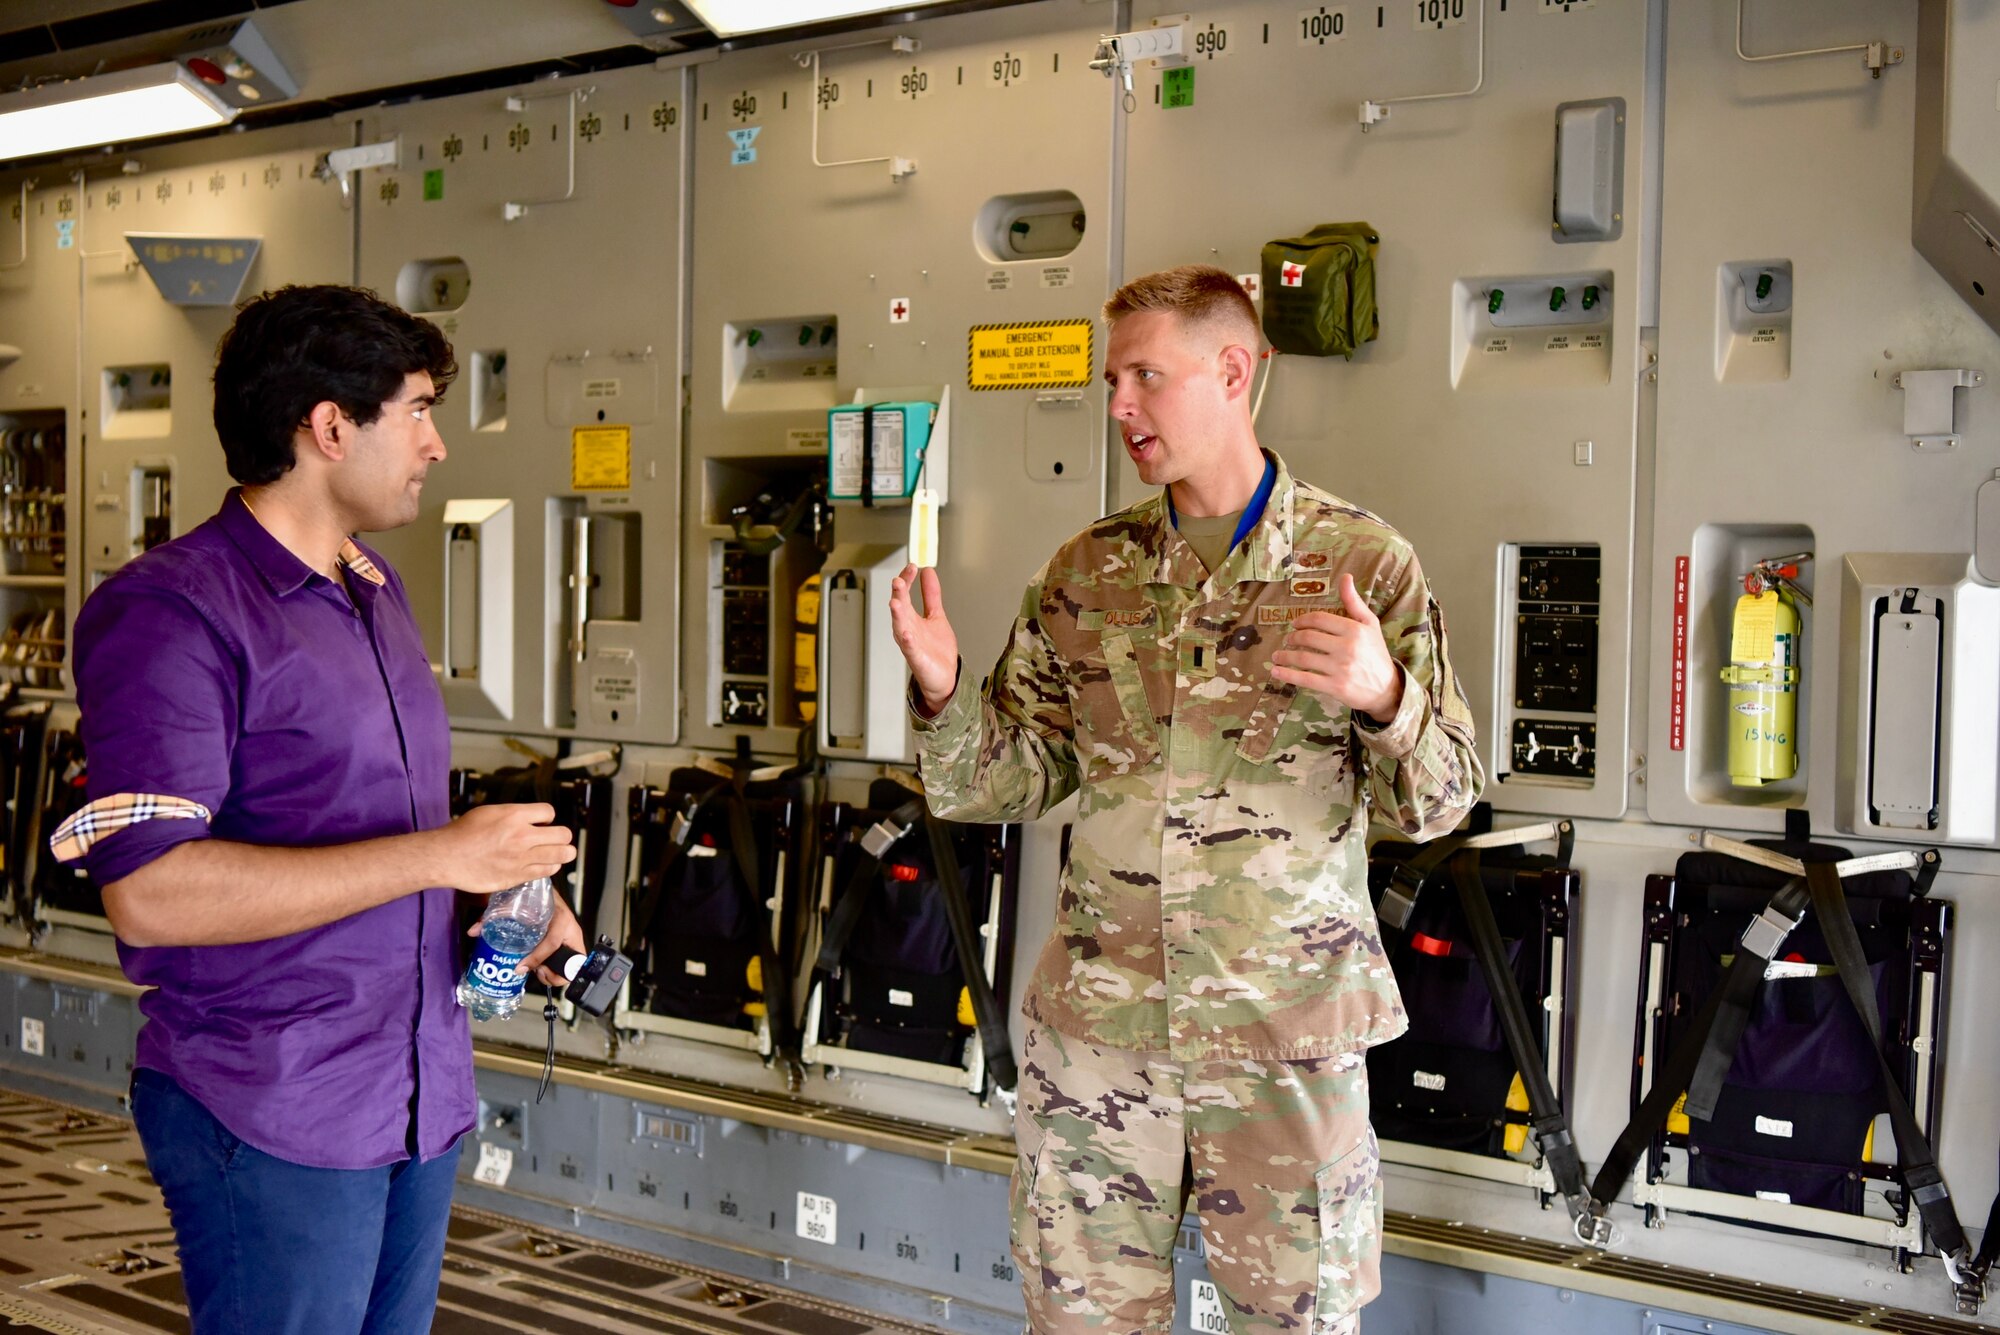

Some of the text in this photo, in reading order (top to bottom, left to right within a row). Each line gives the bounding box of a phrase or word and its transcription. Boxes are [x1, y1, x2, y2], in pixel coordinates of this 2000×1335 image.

[1418, 0, 1463, 23] 1010
[1301, 13, 1344, 39] 1000
[1196, 29, 1227, 53] 990
[993, 58, 1021, 80] 970
[901, 72, 927, 94] 960
[733, 97, 757, 117] 940
[653, 107, 676, 127] 930
[579, 117, 601, 137] 920
[509, 127, 530, 148] 910
[1006, 331, 1053, 344] EMERGENCY
[1752, 335, 1776, 343] OXYGEN
[979, 344, 1081, 359] MANUAL GEAR EXTENSION
[1017, 362, 1037, 370] DEPLOY
[1021, 371, 1037, 379] DOWN
[1040, 370, 1051, 378] FULL
[1054, 369, 1074, 377] STROKE
[1572, 548, 1579, 557] 6
[1104, 611, 1141, 625] OLLIS
[1542, 604, 1550, 614] 17
[1572, 605, 1580, 614] 18
[1674, 615, 1684, 748] EXTINGUISHER
[1746, 728, 1787, 744] 15 WG
[492, 954, 521, 965] DASAN
[803, 1196, 831, 1215] AD 16
[806, 1220, 826, 1239] 960
[896, 1242, 917, 1261] 970
[991, 1263, 1014, 1282] 980
[1198, 1284, 1214, 1301] AD
[1200, 1312, 1230, 1334] 1000
